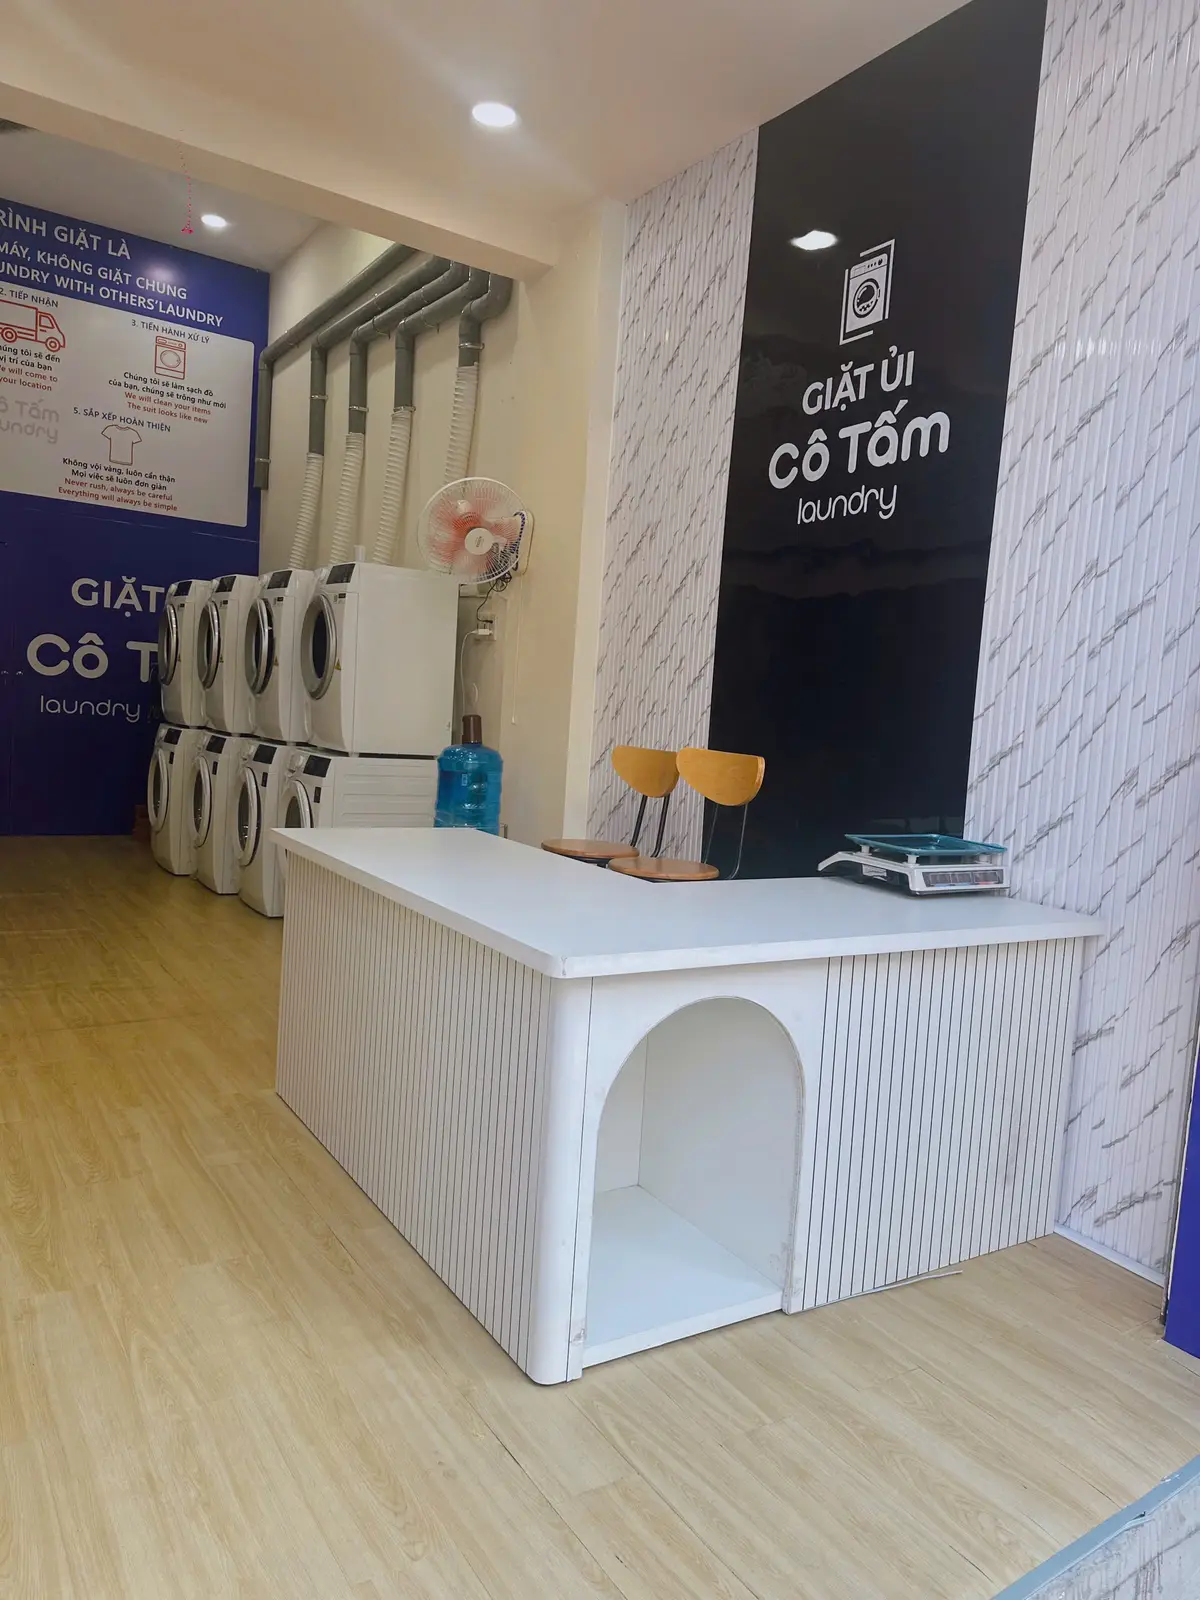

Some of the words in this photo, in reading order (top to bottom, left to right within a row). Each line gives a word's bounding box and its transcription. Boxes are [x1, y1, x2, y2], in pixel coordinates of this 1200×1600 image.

[54, 227, 101, 251] GIẶT
[107, 238, 131, 260] LÀ
[37, 250, 93, 275] KHÔNG
[98, 267, 132, 285] GIẶT
[136, 276, 187, 300] CHUNG
[54, 274, 94, 296] WITH
[9, 290, 29, 301] TIẾP
[31, 295, 59, 308] NHẬN
[131, 319, 139, 328] 3.
[141, 321, 159, 332] TIẾN
[161, 326, 186, 338] HÀNH
[20, 349, 32, 357] tôi
[45, 353, 61, 363] đến
[20, 359, 35, 368] của
[37, 362, 53, 372] bạn
[8, 367, 23, 375] will
[25, 371, 47, 381] come
[49, 375, 58, 383] to
[19, 379, 52, 391] location
[123, 371, 148, 385] Chúng
[172, 382, 185, 391] làm
[186, 386, 202, 395] sạch
[802, 361, 874, 415] GIẶT
[880, 345, 915, 392] ỦI
[108, 379, 122, 388] của
[141, 386, 165, 398] chúng
[197, 397, 212, 406] như
[124, 391, 137, 400] We
[138, 394, 152, 403] will
[153, 397, 172, 407] clean
[174, 402, 190, 411] your
[192, 405, 211, 415] items
[14, 398, 60, 423] Tấm
[73, 407, 81, 415] 5.
[102, 411, 117, 421] XẾP
[119, 415, 144, 427] HOÀN
[127, 401, 141, 411] The
[143, 405, 157, 414] suit
[158, 407, 178, 418] looks
[179, 412, 192, 421] like
[194, 416, 208, 424] new
[768, 428, 830, 489] Cô
[838, 399, 951, 474] Tấm
[62, 457, 88, 470] Không
[90, 463, 102, 471] vội
[126, 468, 143, 477] luôn
[159, 475, 176, 483] thận
[71, 469, 87, 478] Mọi
[88, 472, 104, 481] việc
[116, 476, 133, 485] luôn
[58, 487, 99, 500] Everything
[116, 496, 141, 506] always
[143, 499, 152, 507] be
[154, 503, 178, 511] simple
[64, 477, 88, 487] Never
[110, 485, 135, 495] always
[148, 492, 173, 501] careful
[797, 485, 898, 525] laundry
[71, 575, 165, 618] GIẶT
[27, 632, 109, 679] Cô
[40, 695, 141, 723] laundry
